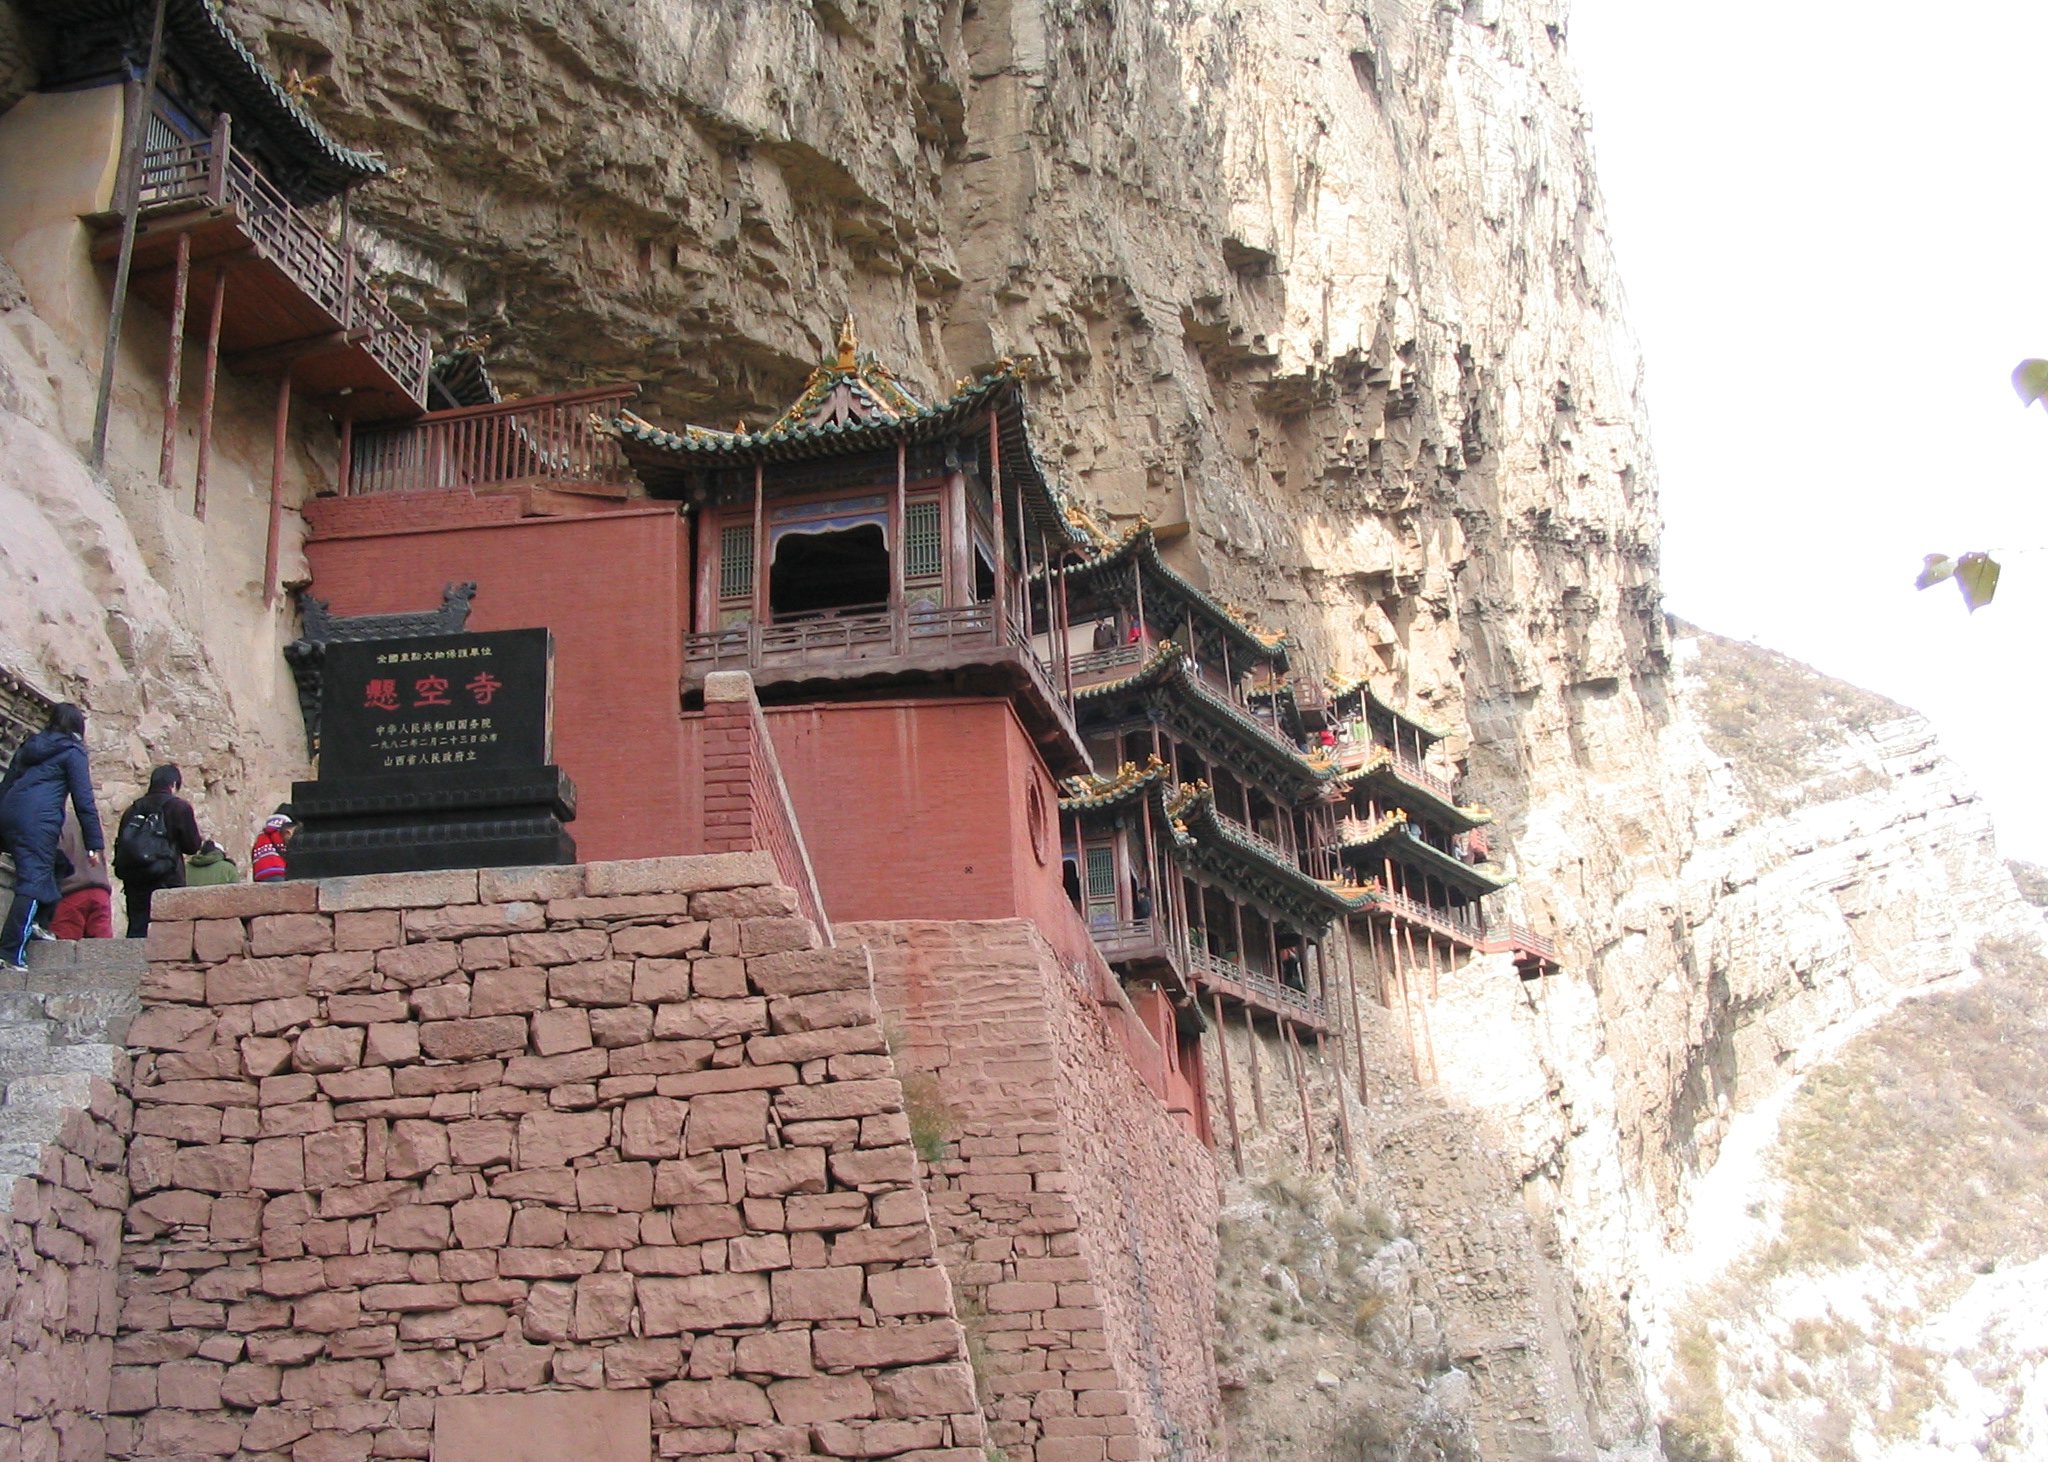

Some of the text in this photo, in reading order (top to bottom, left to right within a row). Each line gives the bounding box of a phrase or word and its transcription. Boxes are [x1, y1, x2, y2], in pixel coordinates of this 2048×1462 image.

[364, 671, 503, 710] 懸空寺
[375, 717, 492, 736] 中华人民共和国国务院
[370, 733, 499, 749] 一九八二年二月二十三日公布
[383, 750, 477, 767] 山西省人民政府立
